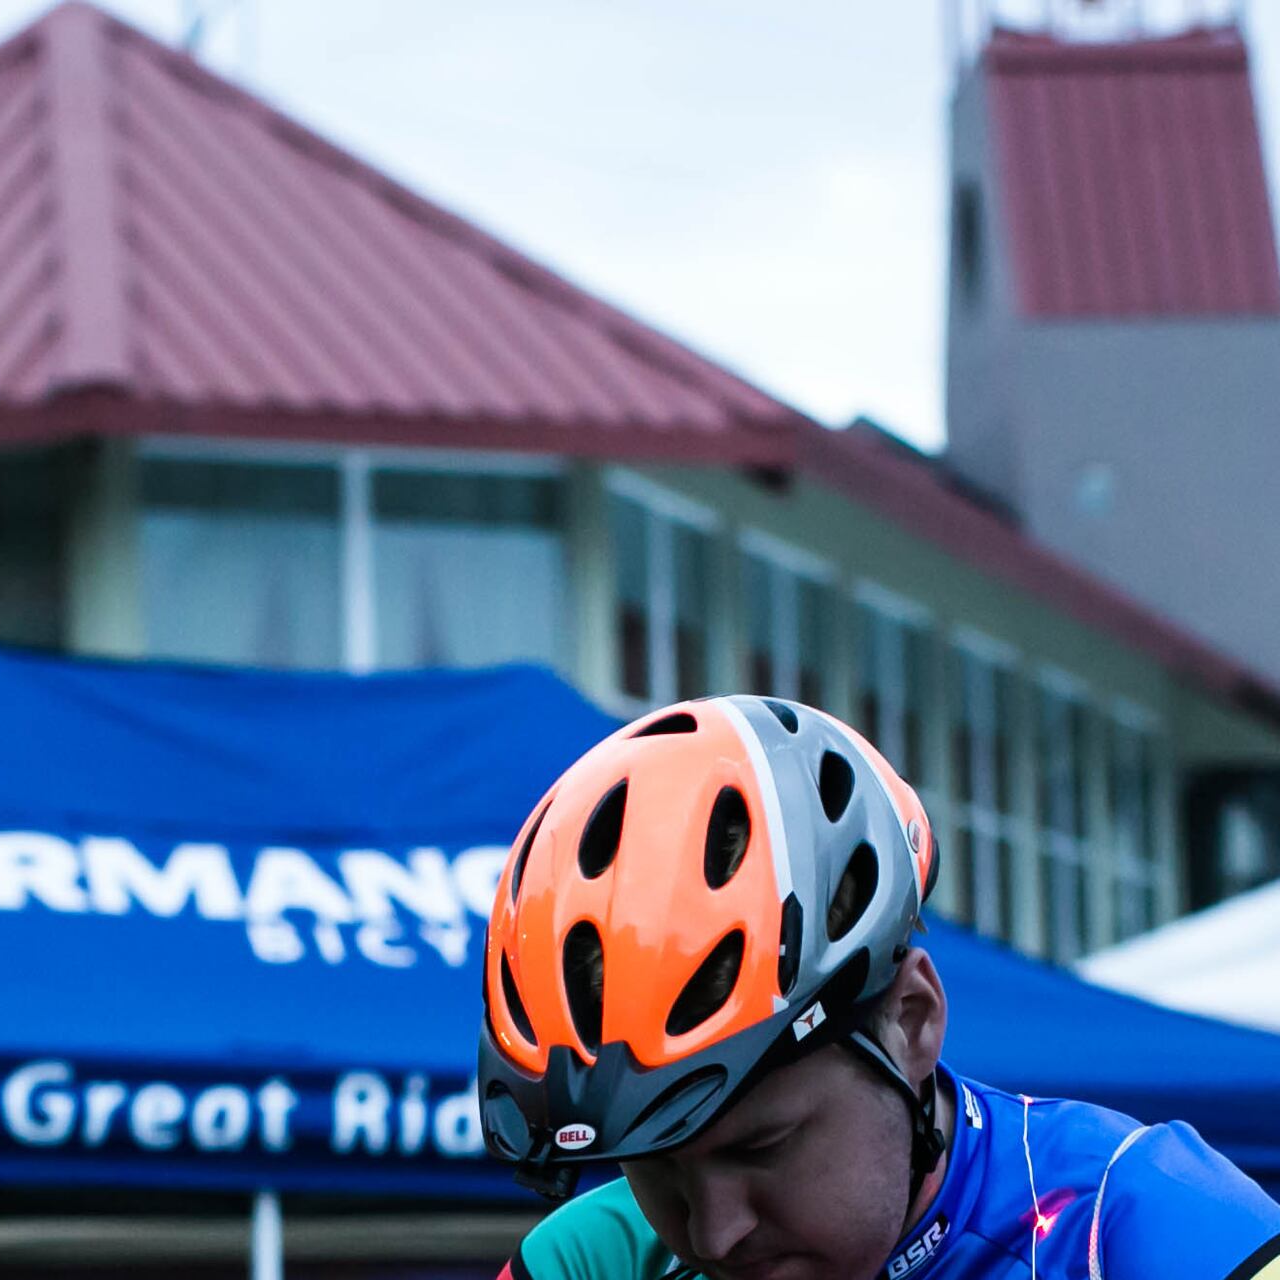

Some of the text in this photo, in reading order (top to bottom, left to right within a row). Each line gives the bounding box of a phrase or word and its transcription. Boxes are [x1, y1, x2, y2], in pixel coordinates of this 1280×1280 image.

[1, 1061, 299, 1152] Great
[330, 1071, 488, 1159] Rid
[559, 1130, 589, 1143] BELL
